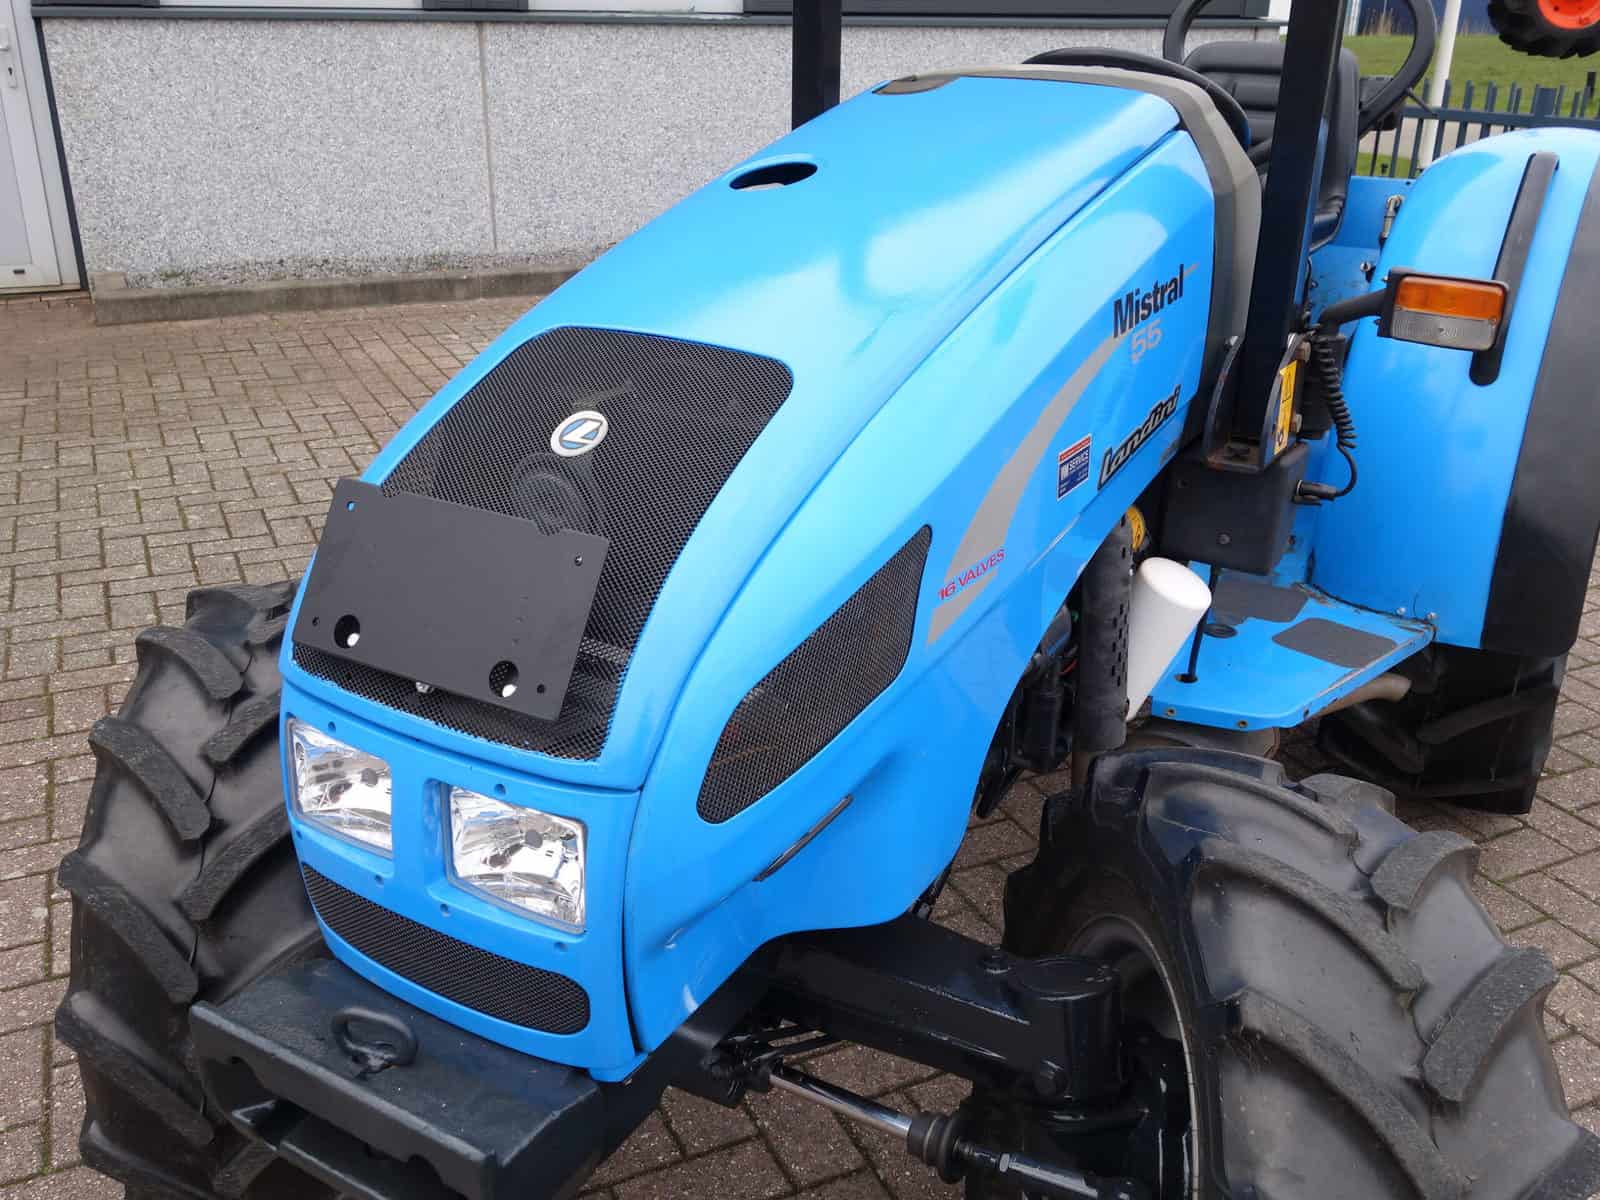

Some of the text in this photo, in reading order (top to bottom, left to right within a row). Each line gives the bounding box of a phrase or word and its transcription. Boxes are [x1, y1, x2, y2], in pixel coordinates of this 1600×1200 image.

[1113, 263, 1184, 339] Mistral
[1131, 318, 1163, 363] 55
[1098, 384, 1180, 490] Landini
[938, 547, 1006, 601] 16 VALVES
